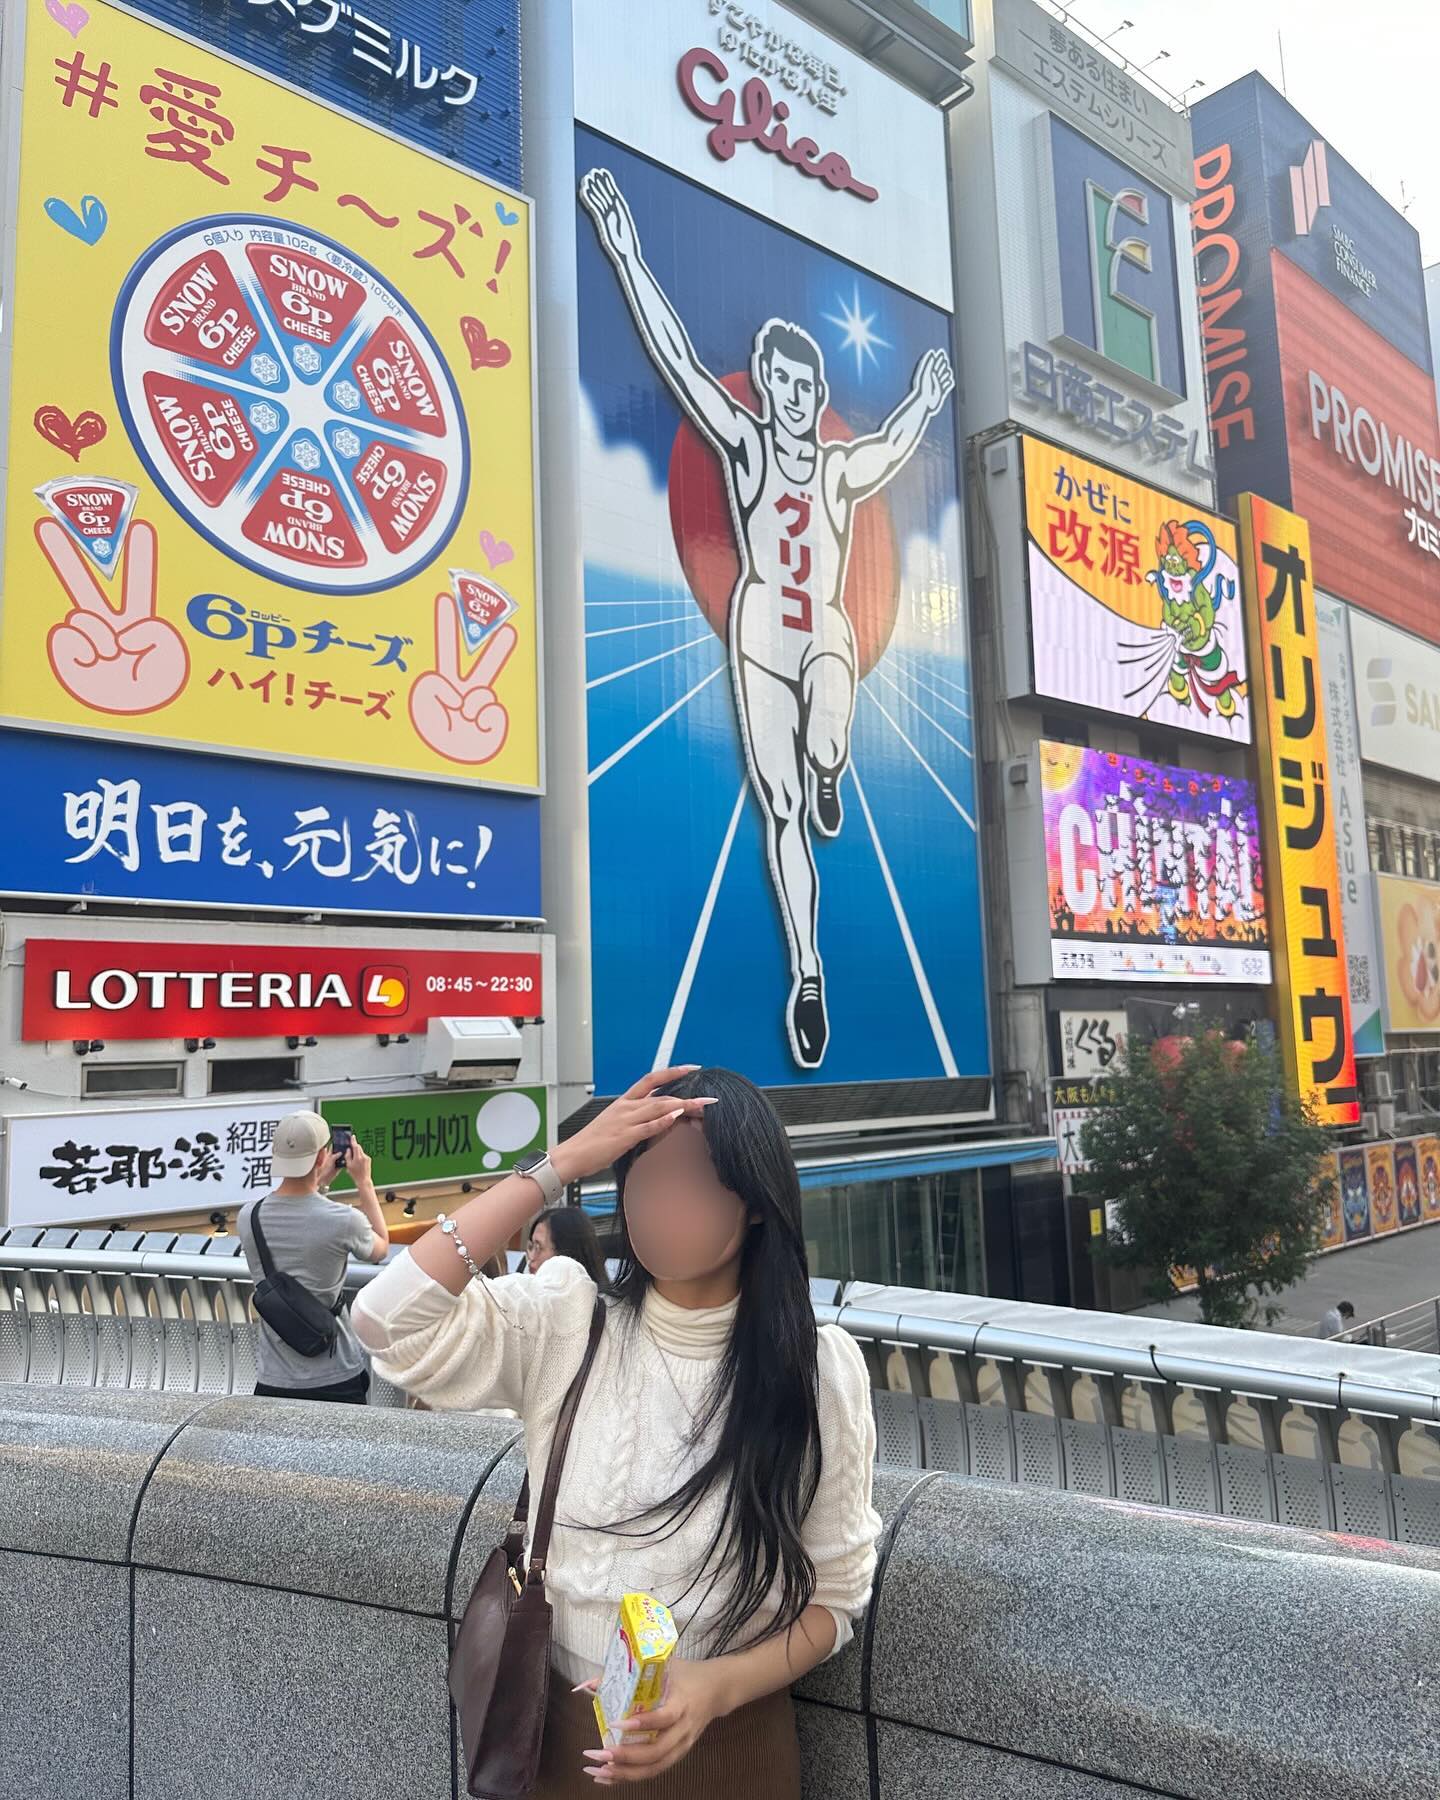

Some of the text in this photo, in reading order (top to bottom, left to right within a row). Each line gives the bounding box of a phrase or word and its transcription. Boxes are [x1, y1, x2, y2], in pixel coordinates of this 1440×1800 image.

[1048, 23, 1148, 116] 夢ある住まい
[676, 47, 879, 203] Glico
[1033, 51, 1167, 169] エステムシリーズ
[203, 229, 243, 246] 6個入り
[269, 254, 348, 299] SNOW
[1334, 241, 1378, 291] CONSUMER
[1336, 256, 1371, 298] FINANCE
[160, 262, 218, 336] SNOW
[191, 298, 217, 327] BRAND
[291, 282, 326, 302] BRAND
[1190, 143, 1256, 448] PROMISE
[222, 325, 257, 365] CHEESE
[283, 316, 331, 343] CHEESE
[356, 364, 385, 414] CHEESE
[388, 340, 439, 418] SNOW
[391, 365, 412, 400] BRAND
[153, 394, 216, 482] SNOW
[189, 414, 213, 453] BRAND
[221, 399, 254, 451] CHEESE
[1308, 369, 1440, 519] PROMISE
[282, 473, 331, 496] CHEESE
[356, 445, 385, 486] CHEESE
[66, 493, 113, 507] SNOW
[390, 471, 437, 541] SNOW
[391, 479, 412, 508] BRAND
[1054, 465, 1131, 524] かぜに
[262, 521, 345, 559] SNOW
[287, 516, 323, 532] BRAND
[1045, 503, 1142, 585] 改源
[1404, 507, 1440, 560] プロミ
[774, 491, 813, 633] グリコ
[466, 583, 500, 608] SNOW
[63, 779, 493, 889] 明日を、元気に!
[1261, 544, 1357, 1105] オリジュウ
[55, 969, 352, 1010] LOTTERIA
[392, 1113, 472, 1161] ピタットハウス
[242, 1155, 273, 1189] 酒
